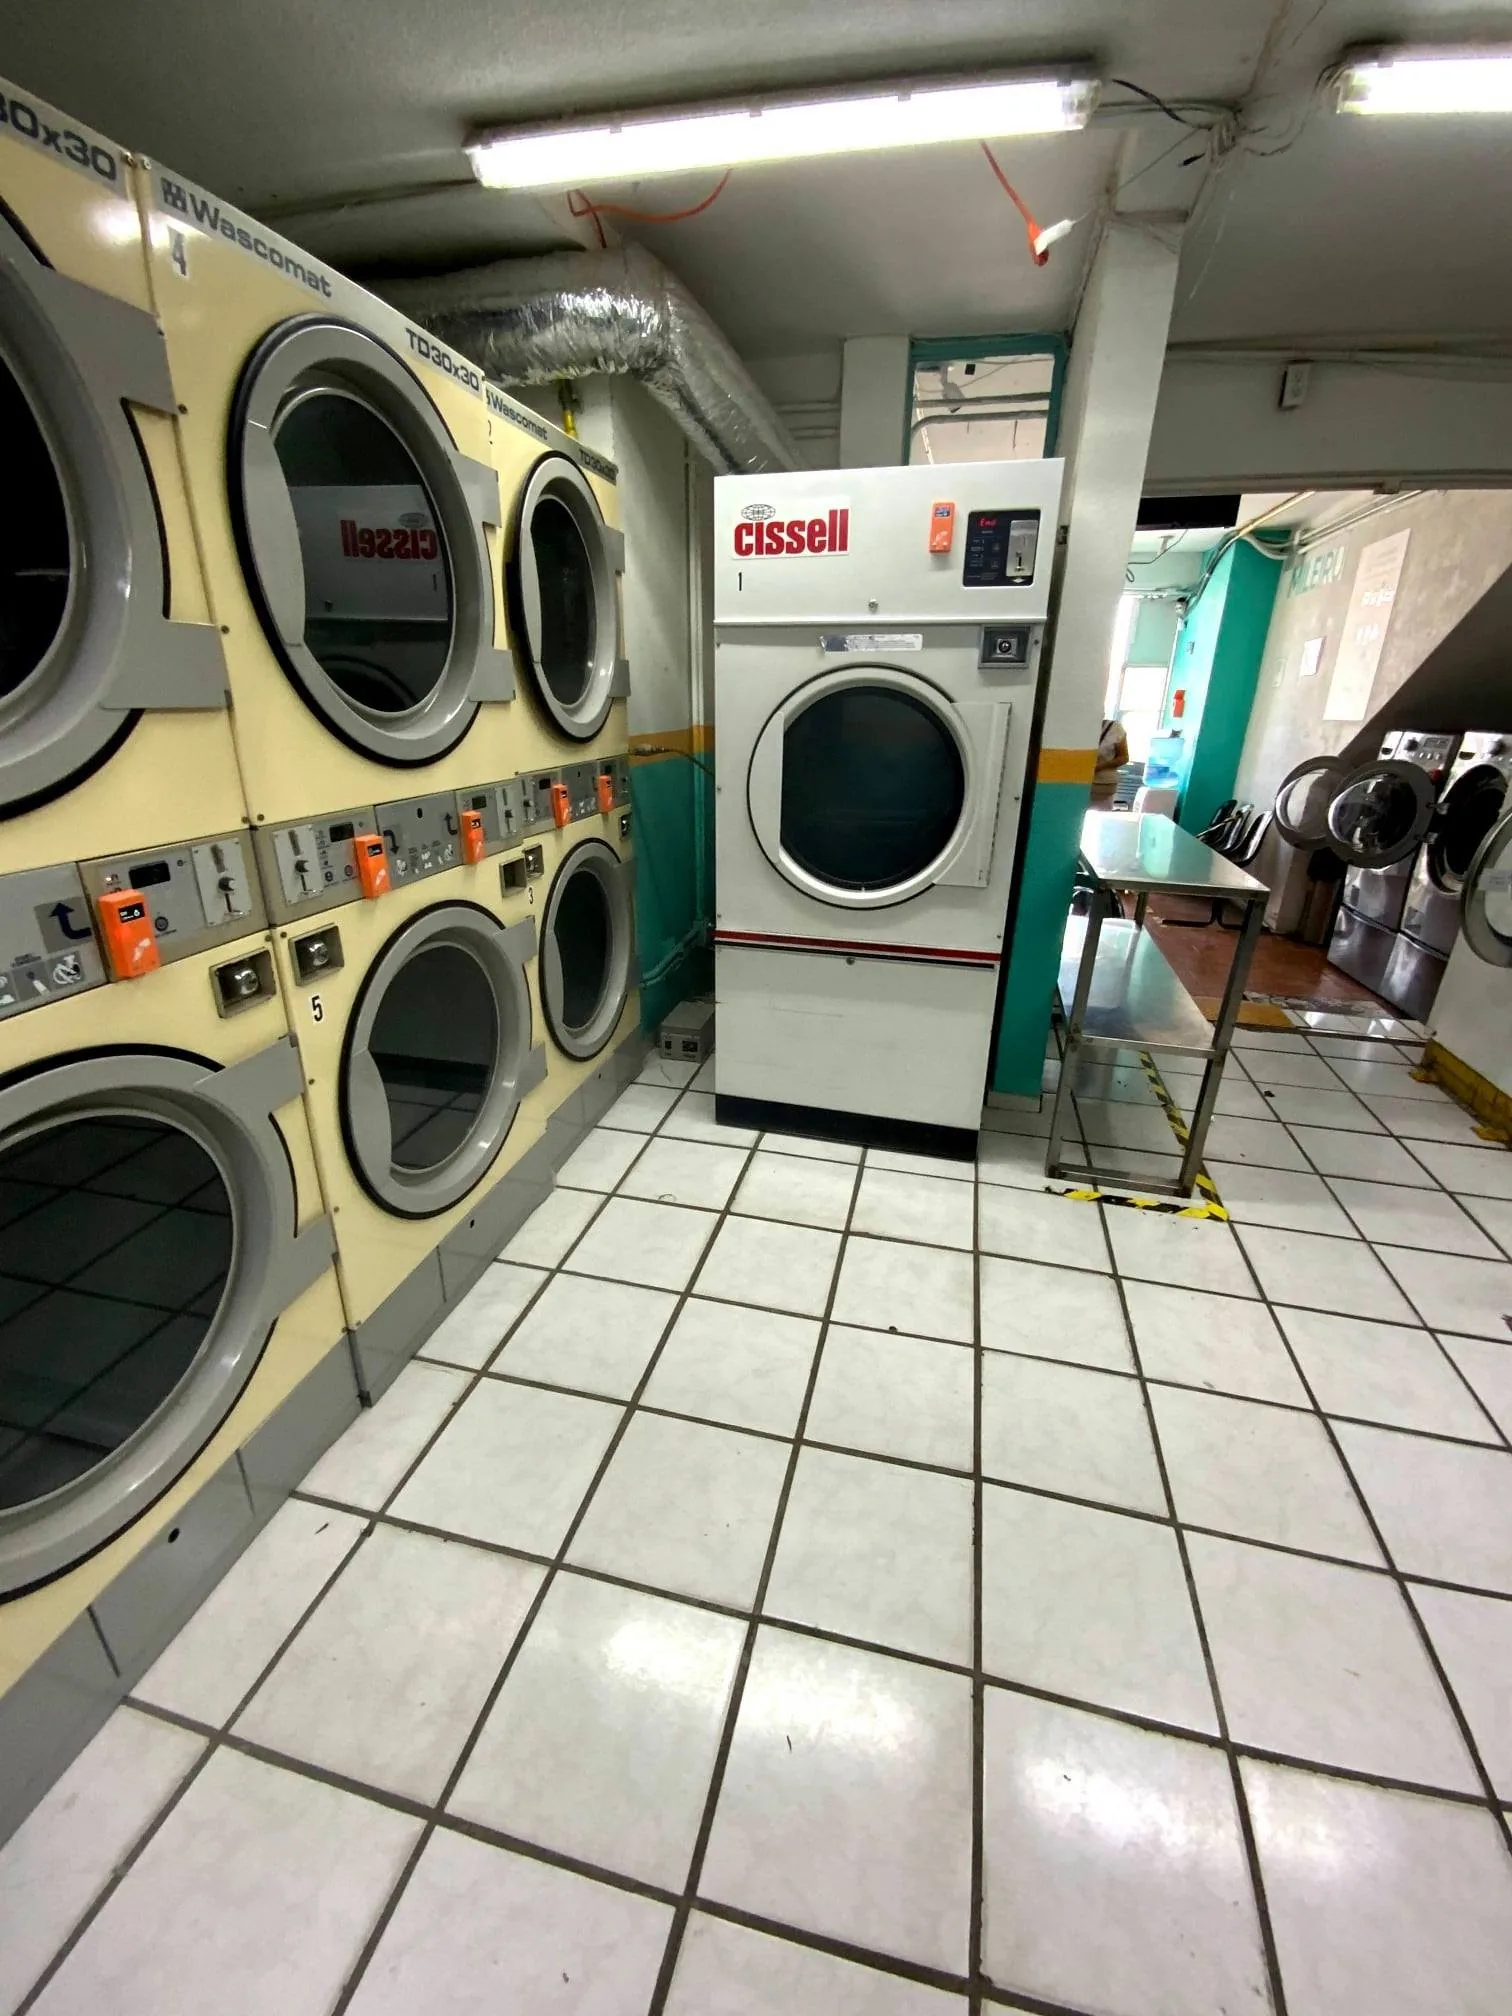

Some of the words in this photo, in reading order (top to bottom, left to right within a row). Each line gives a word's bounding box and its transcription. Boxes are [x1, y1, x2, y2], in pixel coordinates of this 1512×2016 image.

[172, 233, 188, 277] 4
[189, 192, 332, 298] Wascomat
[405, 327, 480, 392] TD30x30
[489, 392, 548, 441] Wascomat
[311, 994, 324, 1022] 5
